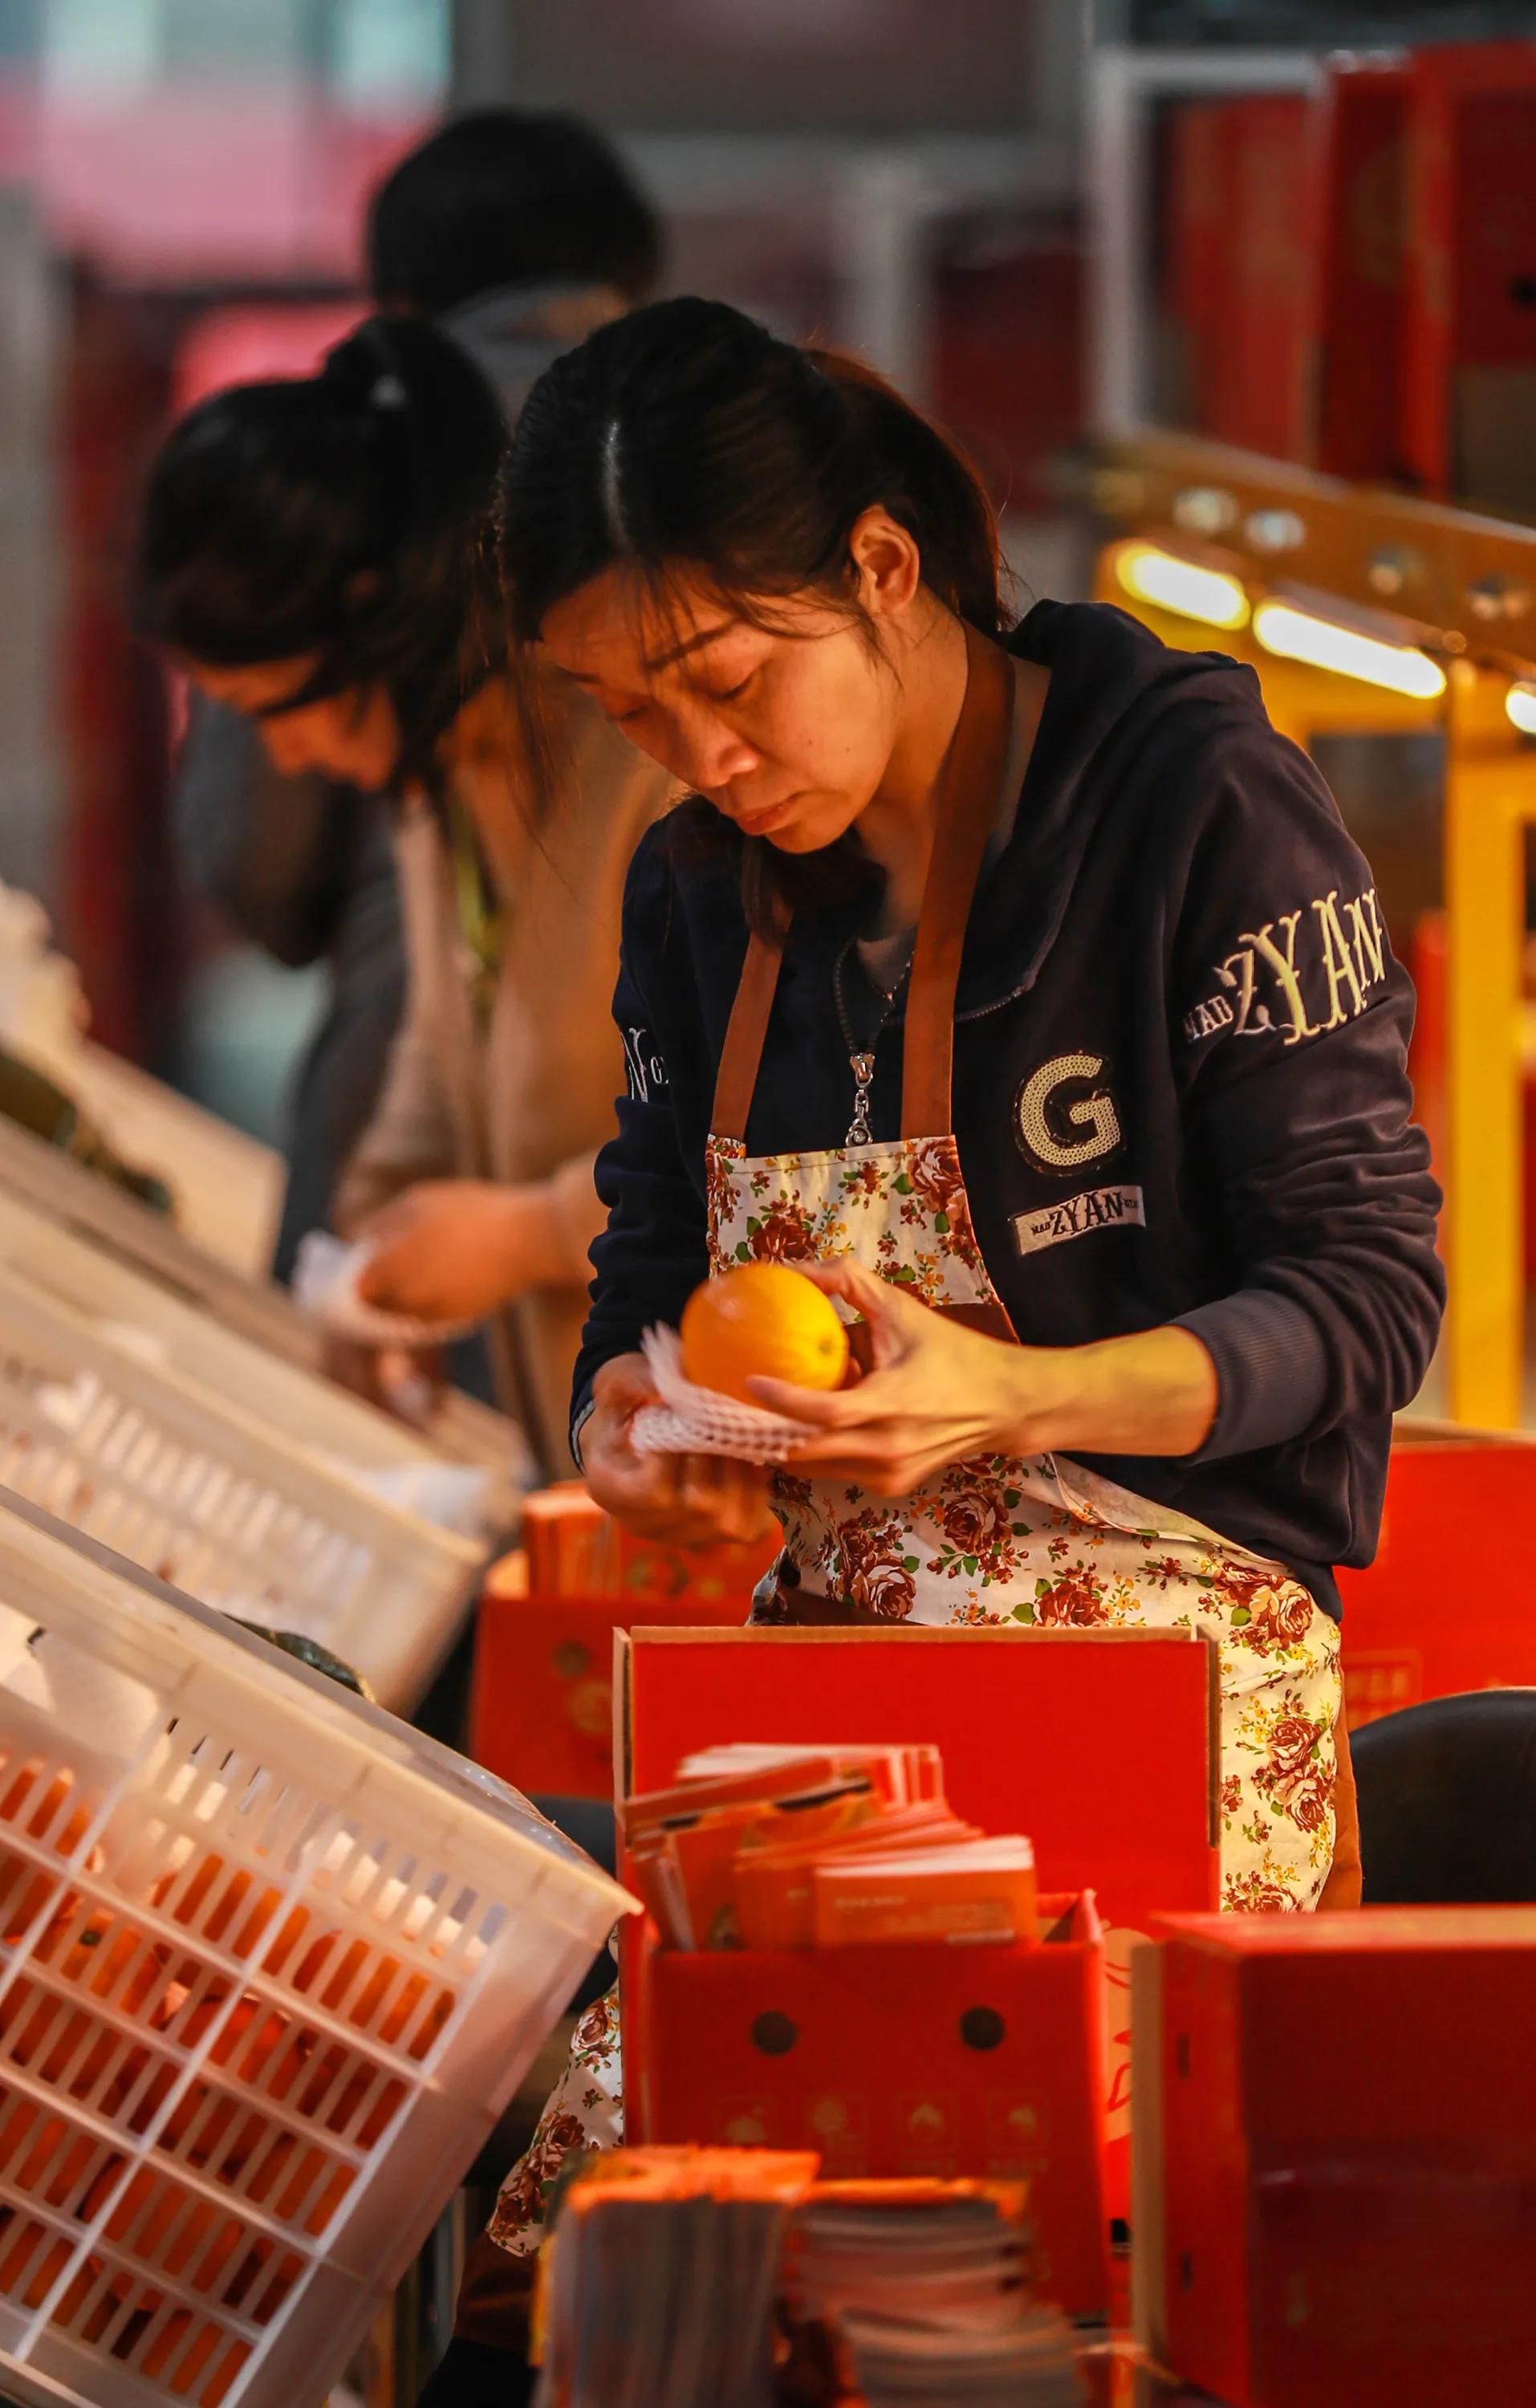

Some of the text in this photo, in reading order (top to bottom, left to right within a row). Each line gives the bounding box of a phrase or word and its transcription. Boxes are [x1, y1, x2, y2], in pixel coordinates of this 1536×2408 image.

[1212, 889, 1385, 1045] ZYAN
[1019, 1054, 1121, 1166] G
[1030, 1191, 1124, 1236] MAD ZYAN
